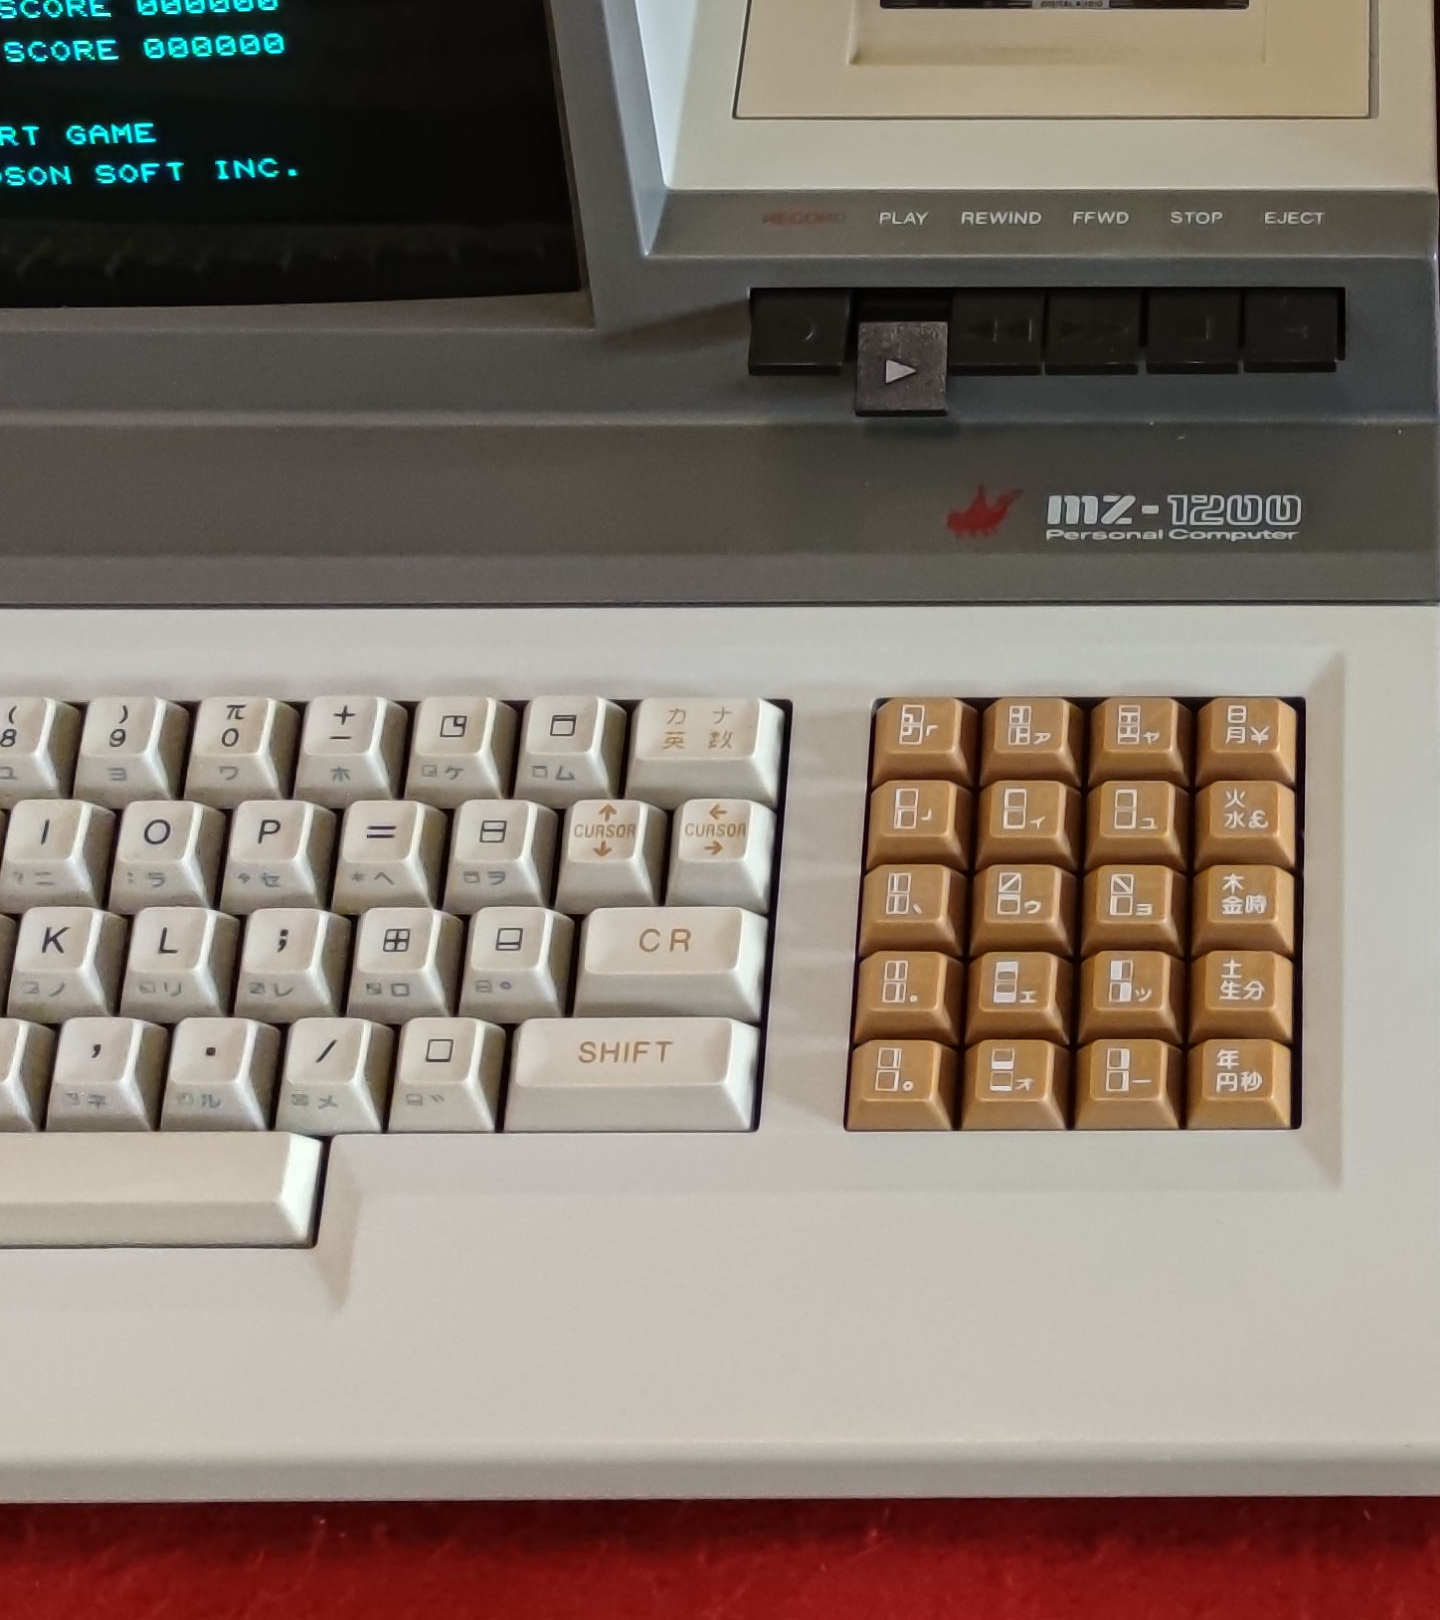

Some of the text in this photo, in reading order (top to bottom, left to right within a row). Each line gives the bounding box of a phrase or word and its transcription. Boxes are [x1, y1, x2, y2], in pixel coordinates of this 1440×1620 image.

[3, 34, 285, 63] SCORE 000000
[66, 122, 157, 145] GAME
[94, 162, 184, 184] SOFT
[214, 158, 299, 181] INC.
[878, 211, 929, 225] PLAY
[961, 211, 1042, 225] REWIND
[1072, 211, 1130, 225] FFWD
[1170, 211, 1223, 225] STOP
[1264, 211, 1326, 225] EJECT
[1046, 529, 1299, 542] Personal Computer
[143, 818, 171, 845] O
[257, 818, 282, 845] P
[574, 822, 637, 839] CURSOR
[684, 821, 747, 839] CURSOR
[638, 928, 692, 952] CR
[577, 1041, 673, 1064] SHIFT
